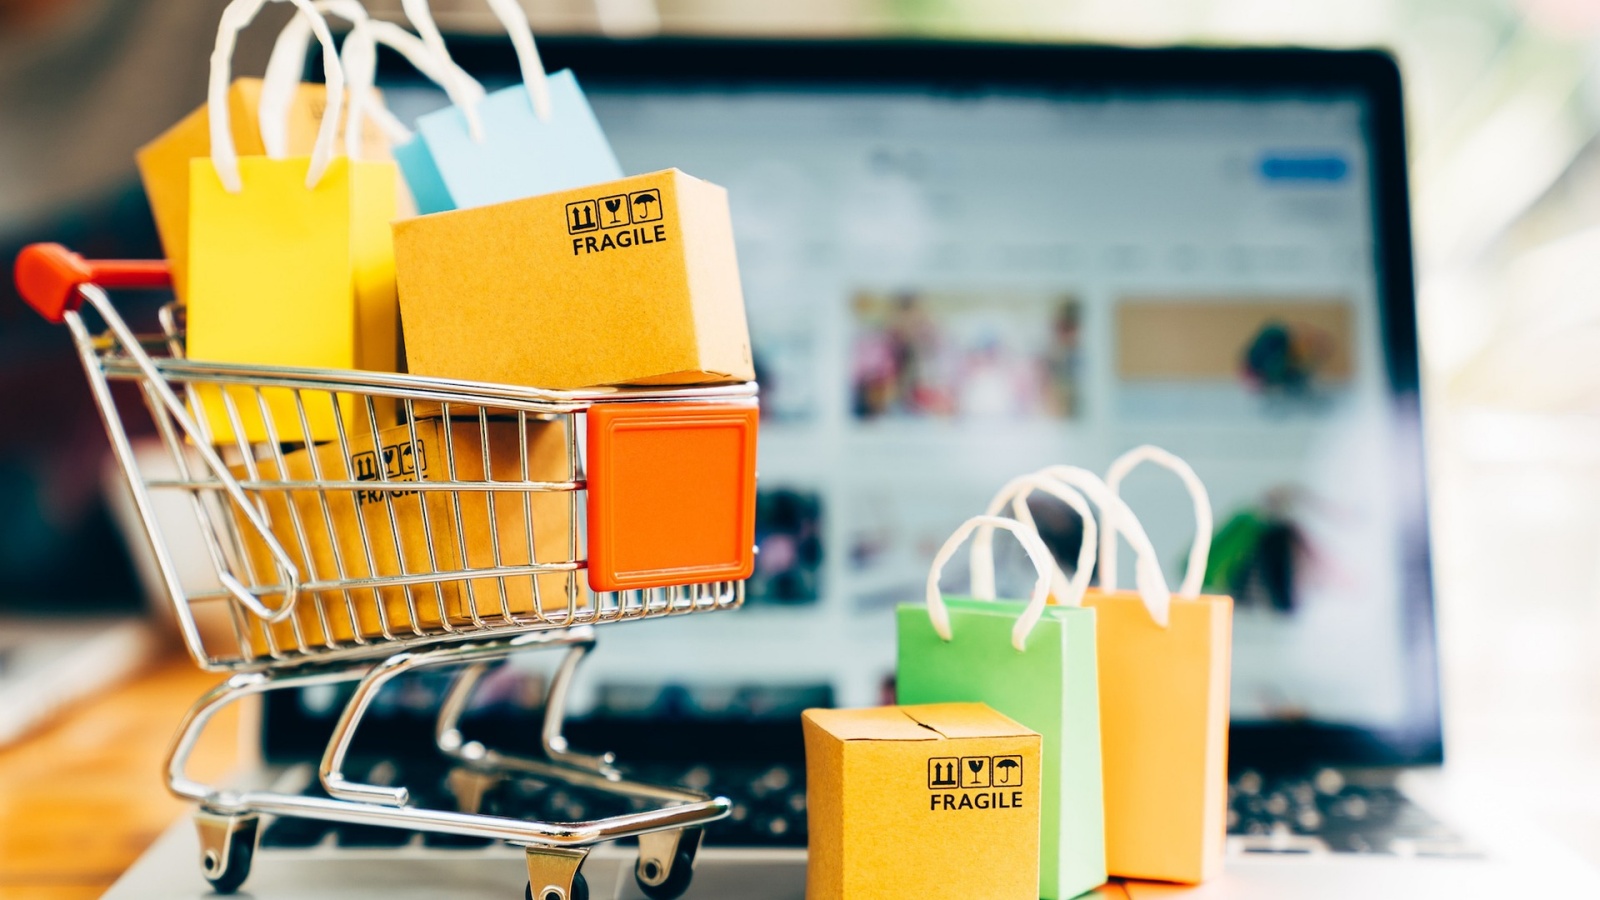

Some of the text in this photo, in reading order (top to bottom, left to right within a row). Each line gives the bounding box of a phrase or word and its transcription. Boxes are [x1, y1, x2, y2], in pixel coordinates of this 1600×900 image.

[573, 224, 666, 256] FRAGILE
[357, 475, 428, 506] FRGIL
[930, 791, 1023, 811] FRAGILE
